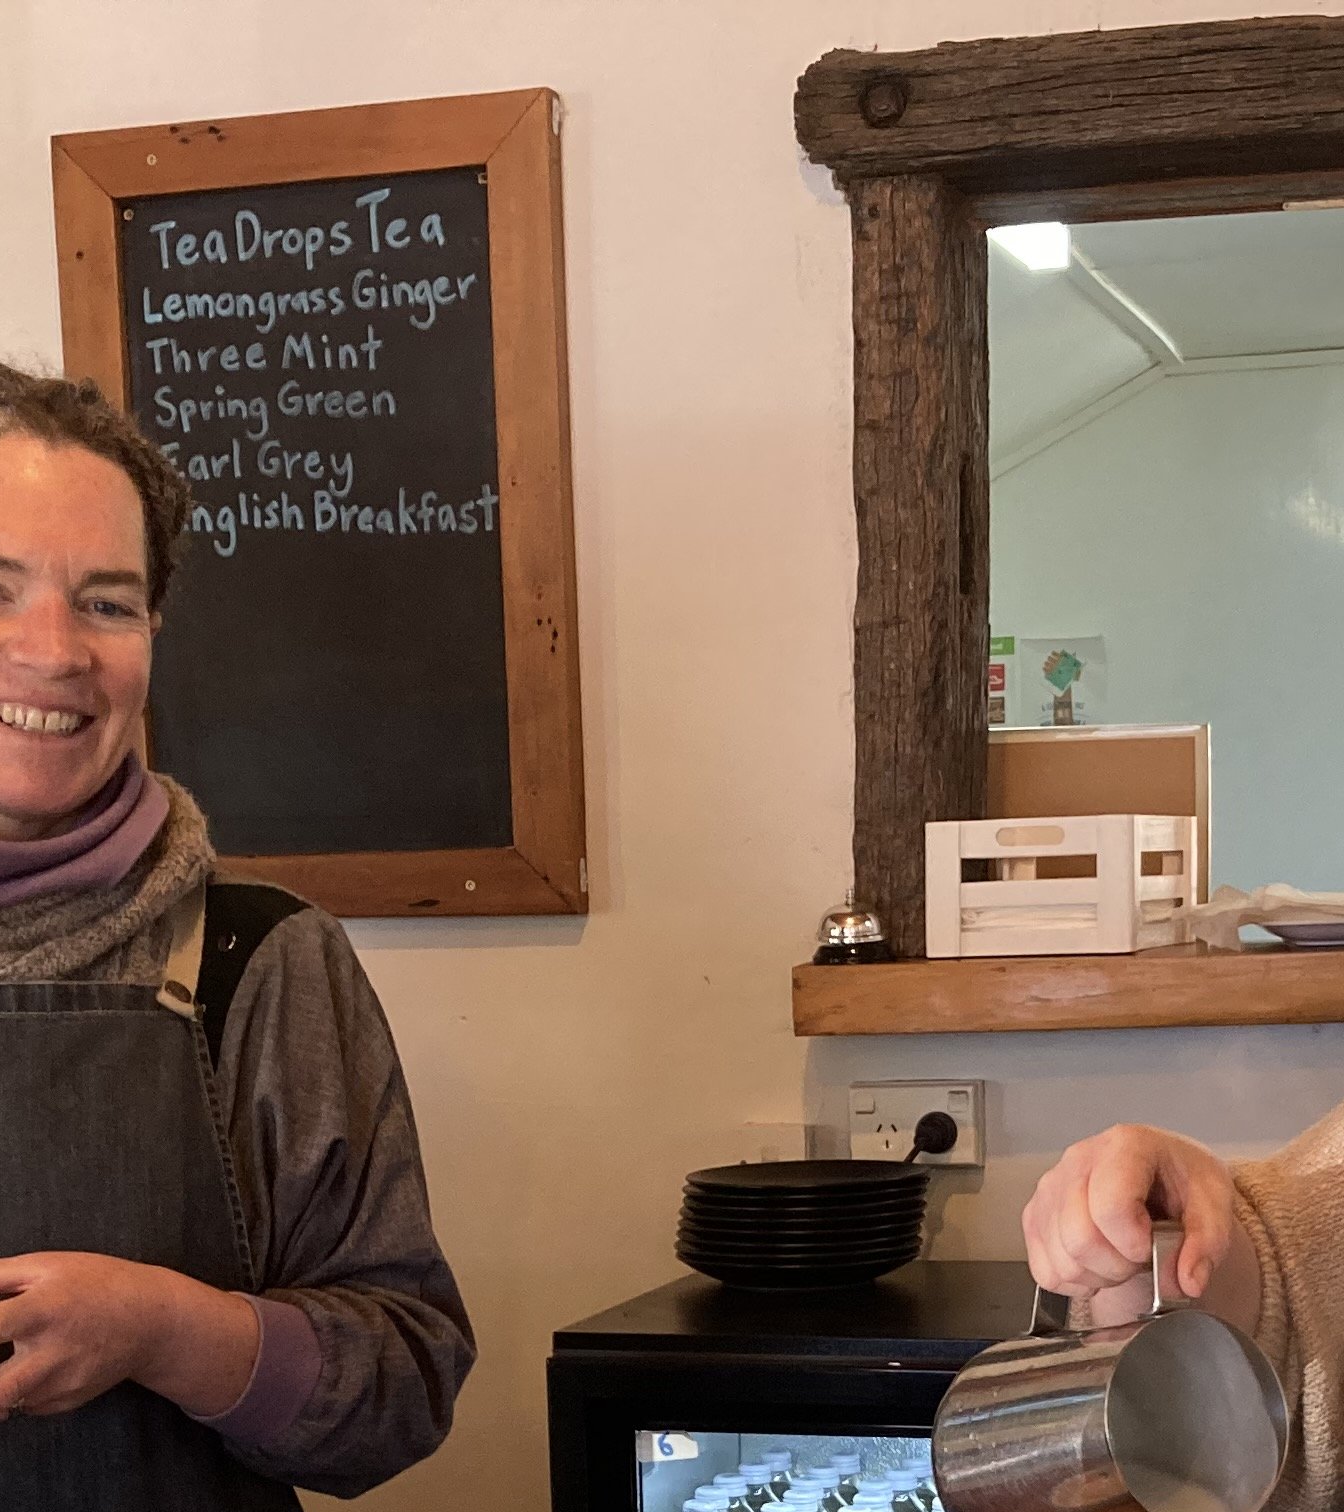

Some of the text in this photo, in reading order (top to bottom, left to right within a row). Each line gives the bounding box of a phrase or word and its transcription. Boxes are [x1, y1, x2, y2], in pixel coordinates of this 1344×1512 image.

[355, 188, 446, 254] Tea
[143, 269, 476, 334] Lemongrass Ginger
[146, 325, 383, 374] Three Mint
[155, 381, 397, 438] Spring Green
[256, 441, 353, 496] Grey
[183, 484, 498, 557] nglish Breakfast
[658, 1431, 674, 1457] 6
